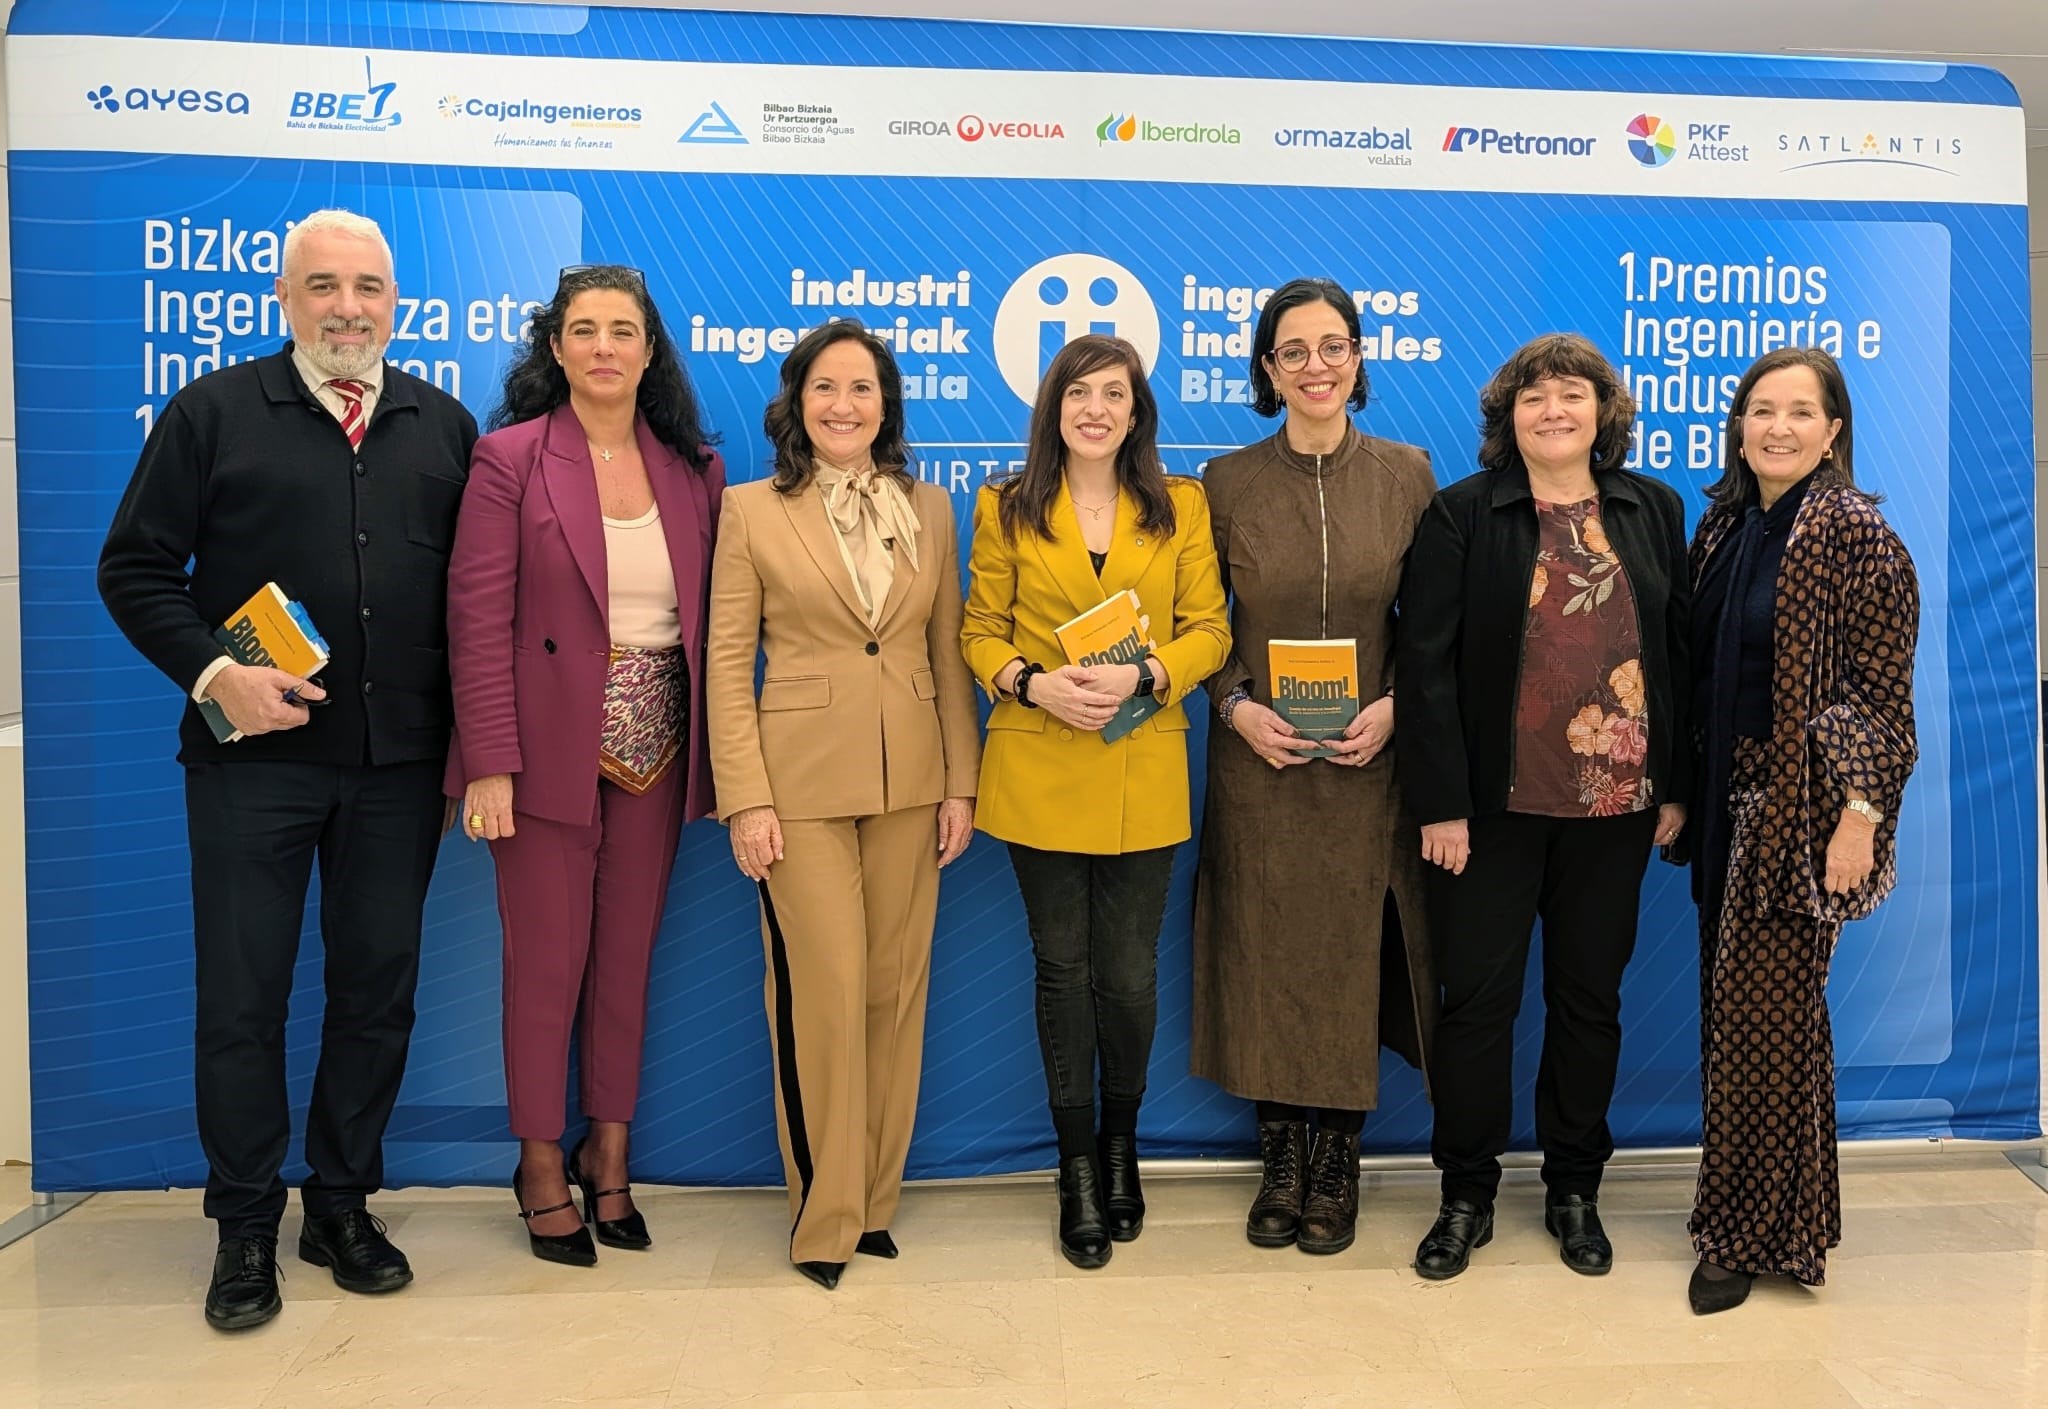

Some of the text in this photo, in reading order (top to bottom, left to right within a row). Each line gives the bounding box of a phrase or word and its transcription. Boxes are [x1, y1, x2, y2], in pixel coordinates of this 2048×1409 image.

[125, 87, 250, 115] ayesa
[763, 103, 832, 114] Bilbao Bizkaia
[307, 121, 317, 129] de
[344, 123, 387, 132] Electricidad
[763, 113, 838, 125] Ur Partzuergoa
[762, 123, 855, 136] Consorcio de Aguas
[762, 134, 826, 144] Bilbao Bizkaia
[888, 120, 1065, 139] GIROA VEOLIA
[1141, 120, 1241, 145] Iberdrola
[1274, 126, 1413, 151] ormazabal
[1688, 123, 1731, 142] PKF
[493, 132, 558, 149] Humanizamos
[574, 136, 613, 149] finanzas
[1480, 127, 1597, 156] Petronor
[1367, 154, 1412, 167] velatia
[1687, 143, 1749, 162] Attest
[144, 216, 295, 274] Bizka
[791, 269, 971, 307] industri
[1857, 318, 1882, 360] e
[1622, 364, 1741, 415] Indus
[1278, 675, 1350, 701] Bloom!
